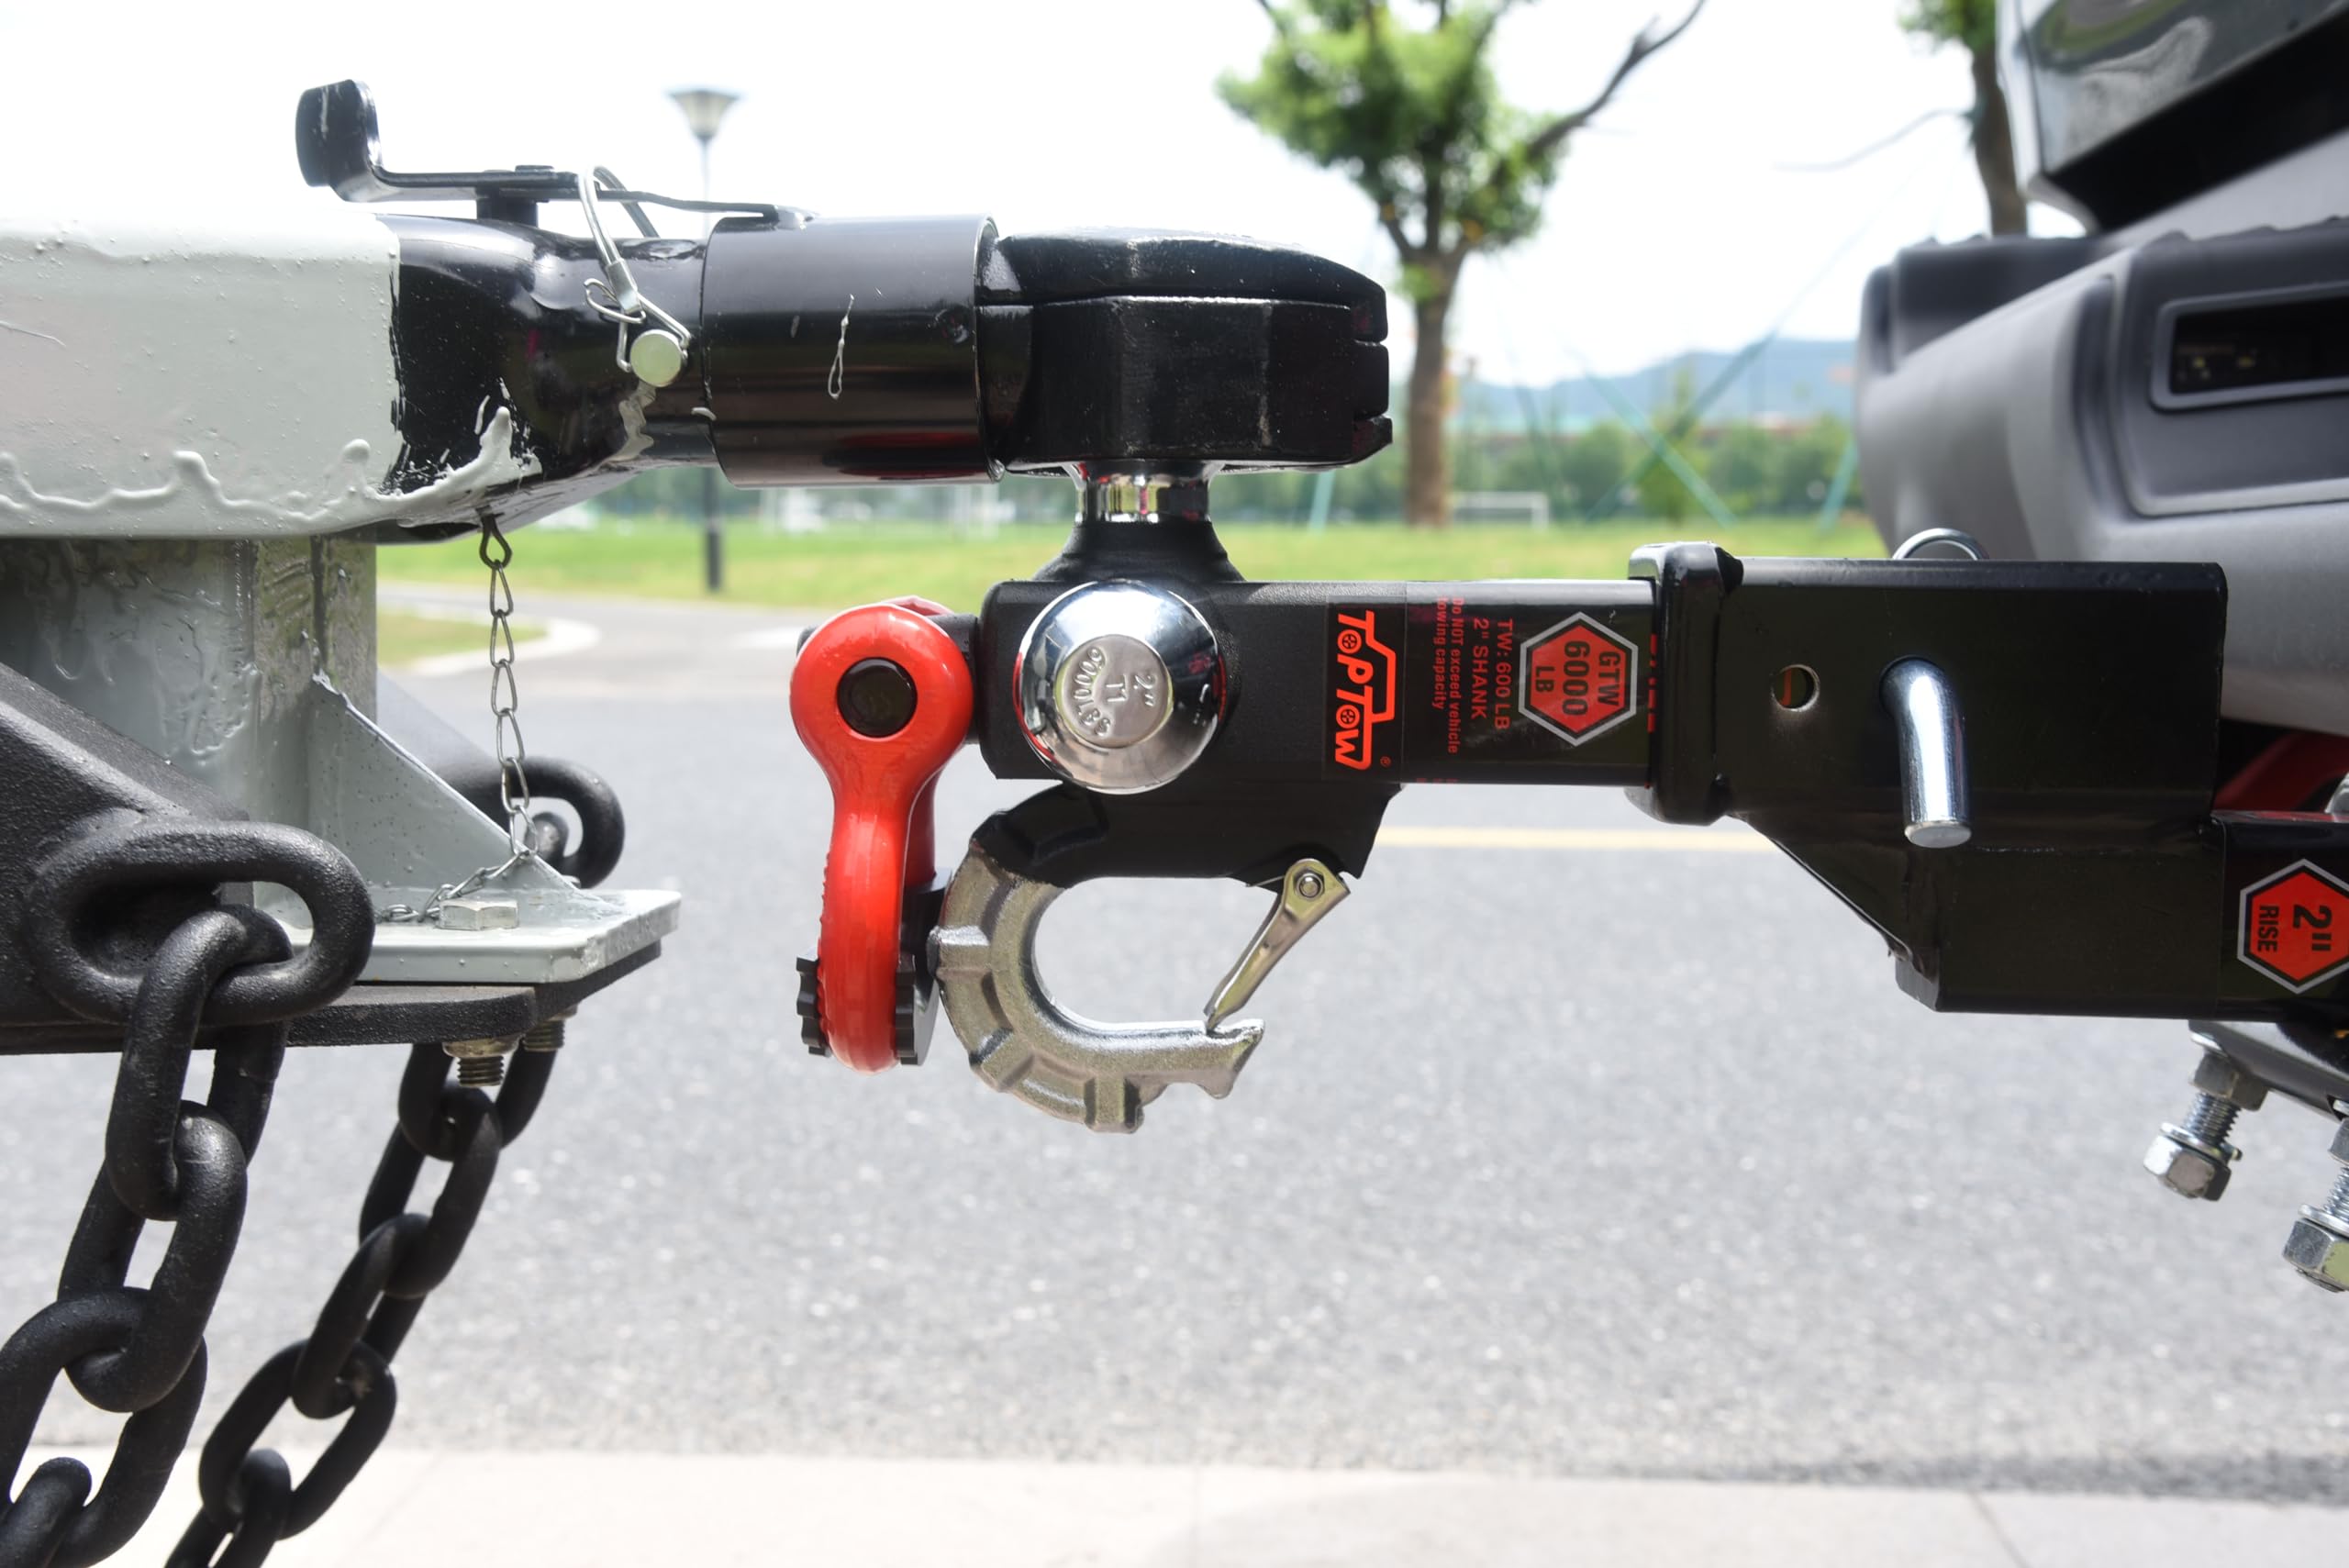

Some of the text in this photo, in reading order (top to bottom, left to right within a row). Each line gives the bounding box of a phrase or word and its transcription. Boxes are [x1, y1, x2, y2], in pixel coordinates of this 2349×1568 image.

[1431, 597, 1450, 710] towing capacity
[1450, 617, 1464, 646] NOT
[1448, 648, 1462, 700] exceed
[1471, 617, 1489, 720] 2" SHANK
[1494, 618, 1513, 730] TW: 600 LB
[1535, 665, 1555, 693] LB
[1562, 640, 1591, 716] 6000
[1598, 651, 1621, 706] GTW
[1447, 702, 1461, 754] vehicle
[2257, 905, 2280, 952] RISE
[2292, 904, 2332, 951] 2"
